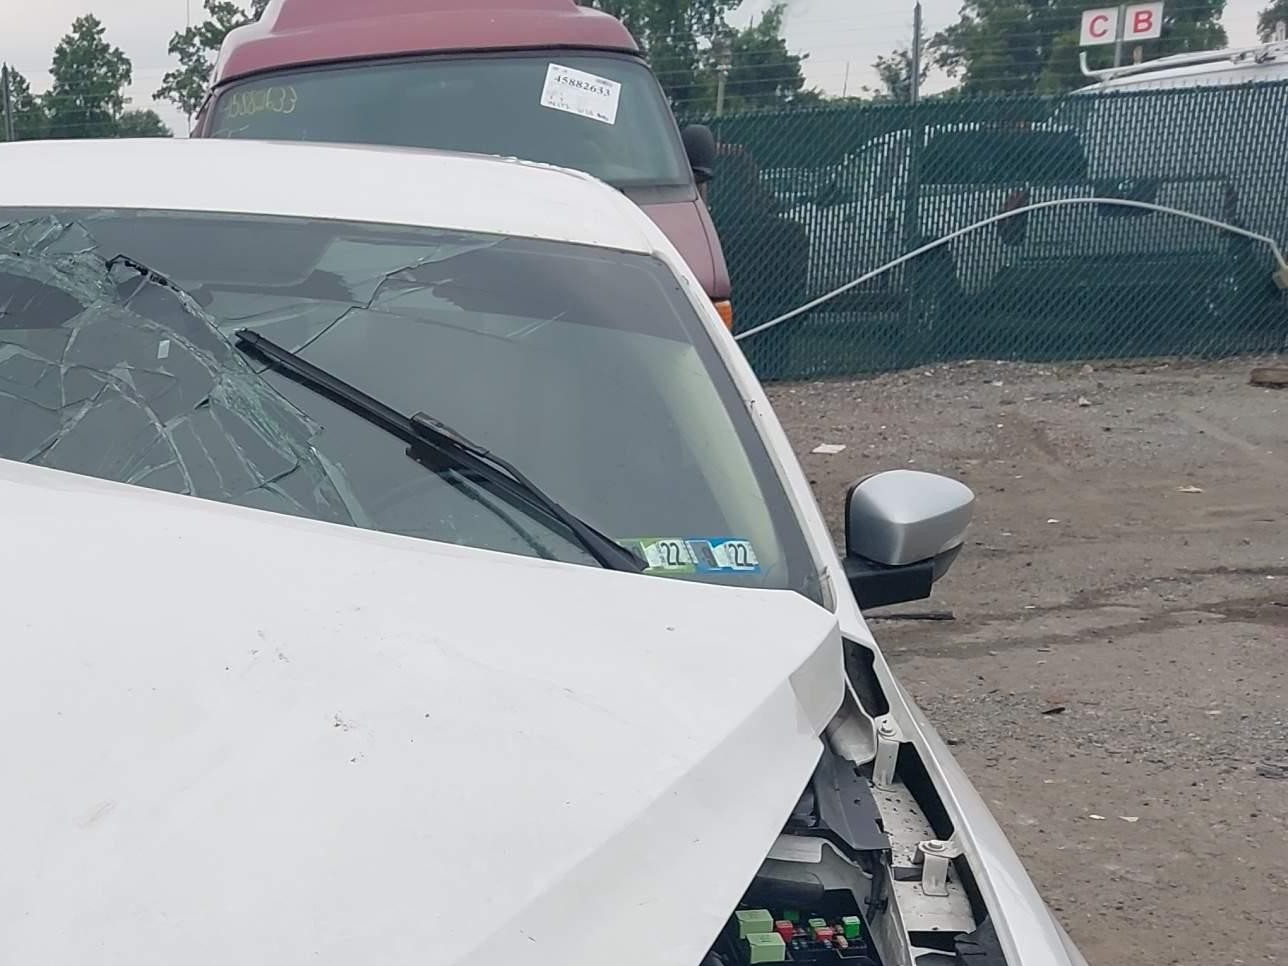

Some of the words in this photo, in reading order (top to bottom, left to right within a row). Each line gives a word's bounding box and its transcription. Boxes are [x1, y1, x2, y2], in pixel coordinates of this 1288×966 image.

[1089, 15, 1109, 38] C
[1133, 10, 1153, 33] B
[660, 542, 686, 566] 22
[728, 543, 758, 567] 22
